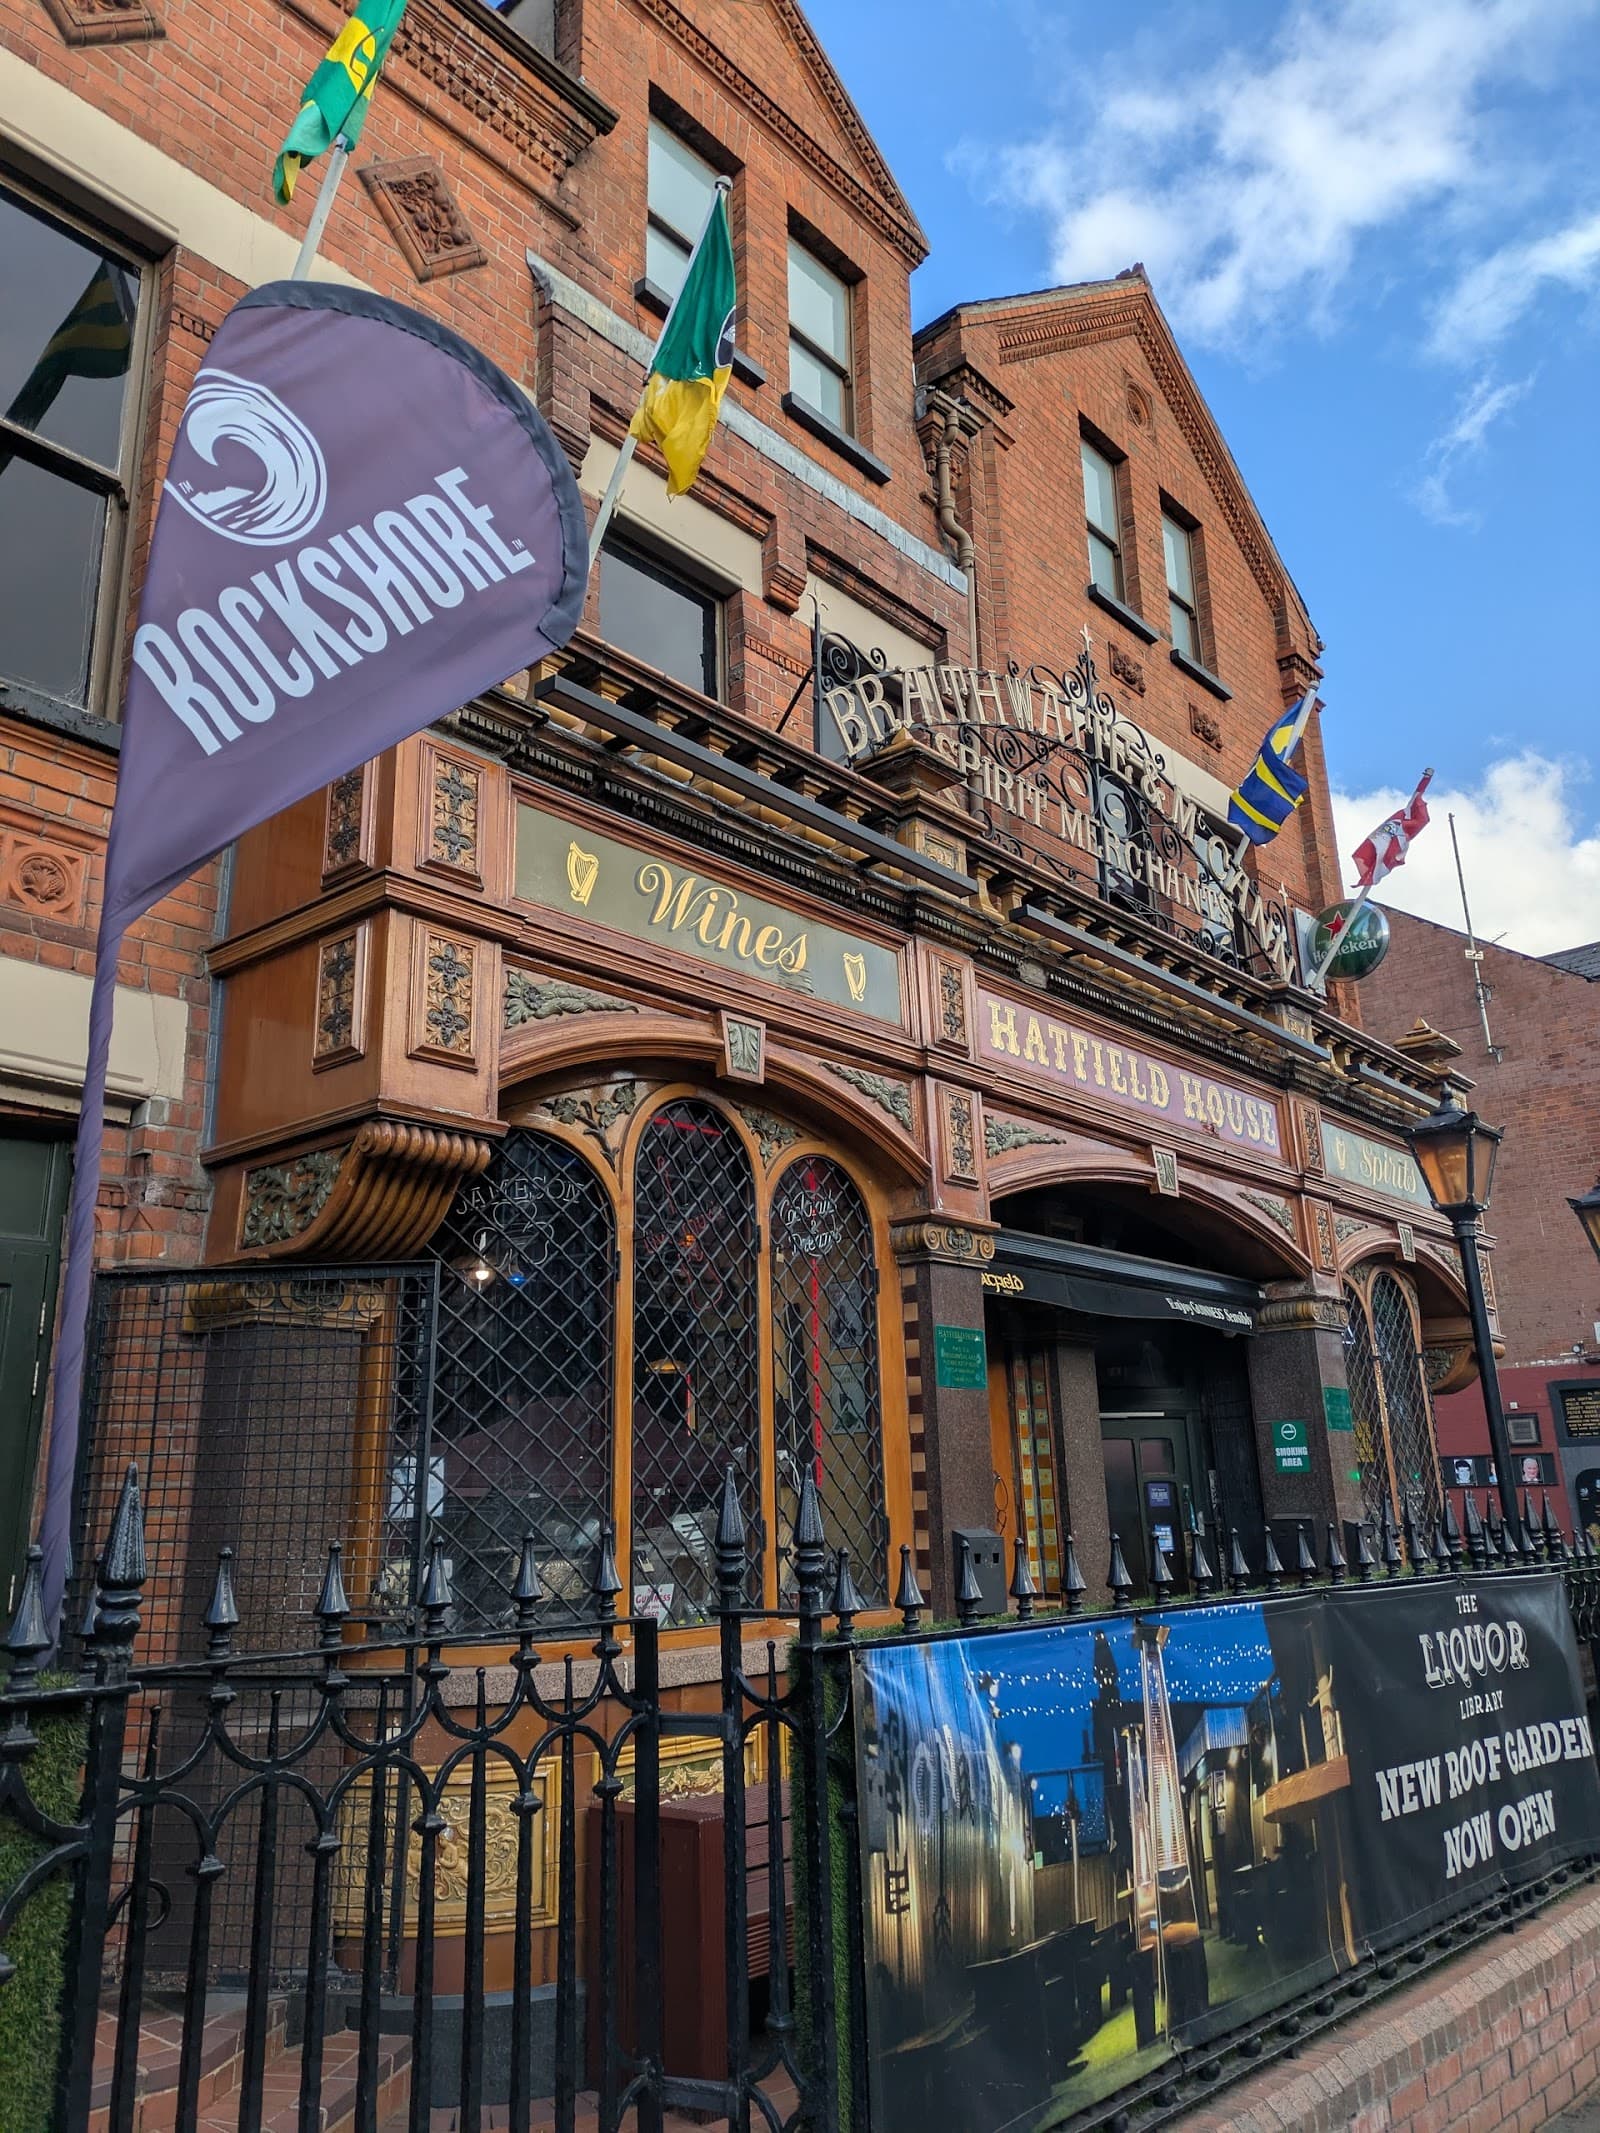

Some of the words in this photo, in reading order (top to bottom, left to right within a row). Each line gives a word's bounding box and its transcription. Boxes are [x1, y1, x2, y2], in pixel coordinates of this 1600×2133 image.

[133, 466, 536, 756] ROCKSHORE
[826, 665, 1134, 784] BRAITHWAITE
[1141, 759, 1166, 814] &
[934, 731, 1049, 828] SPIRIT
[1060, 801, 1236, 931] MERCHANTS
[637, 863, 808, 974] Wines
[1312, 939, 1379, 964] Heeken
[986, 998, 1172, 1112] HATFIELD
[1179, 1073, 1278, 1149] HOUSE
[1359, 1143, 1417, 1195] Spirits
[1275, 1446, 1308, 1457] SMOKING
[1282, 1457, 1303, 1467] AREA
[1455, 1594, 1479, 1614] THE
[1418, 1620, 1529, 1688] LIQUOR
[1459, 1690, 1504, 1720] LIBRARY
[1376, 1756, 1441, 1822] NEW
[1445, 1736, 1502, 1800] ROOF
[1504, 1715, 1595, 1776] GARDEN
[1443, 1810, 1494, 1880] NOW
[1498, 1790, 1557, 1852] OPEN
